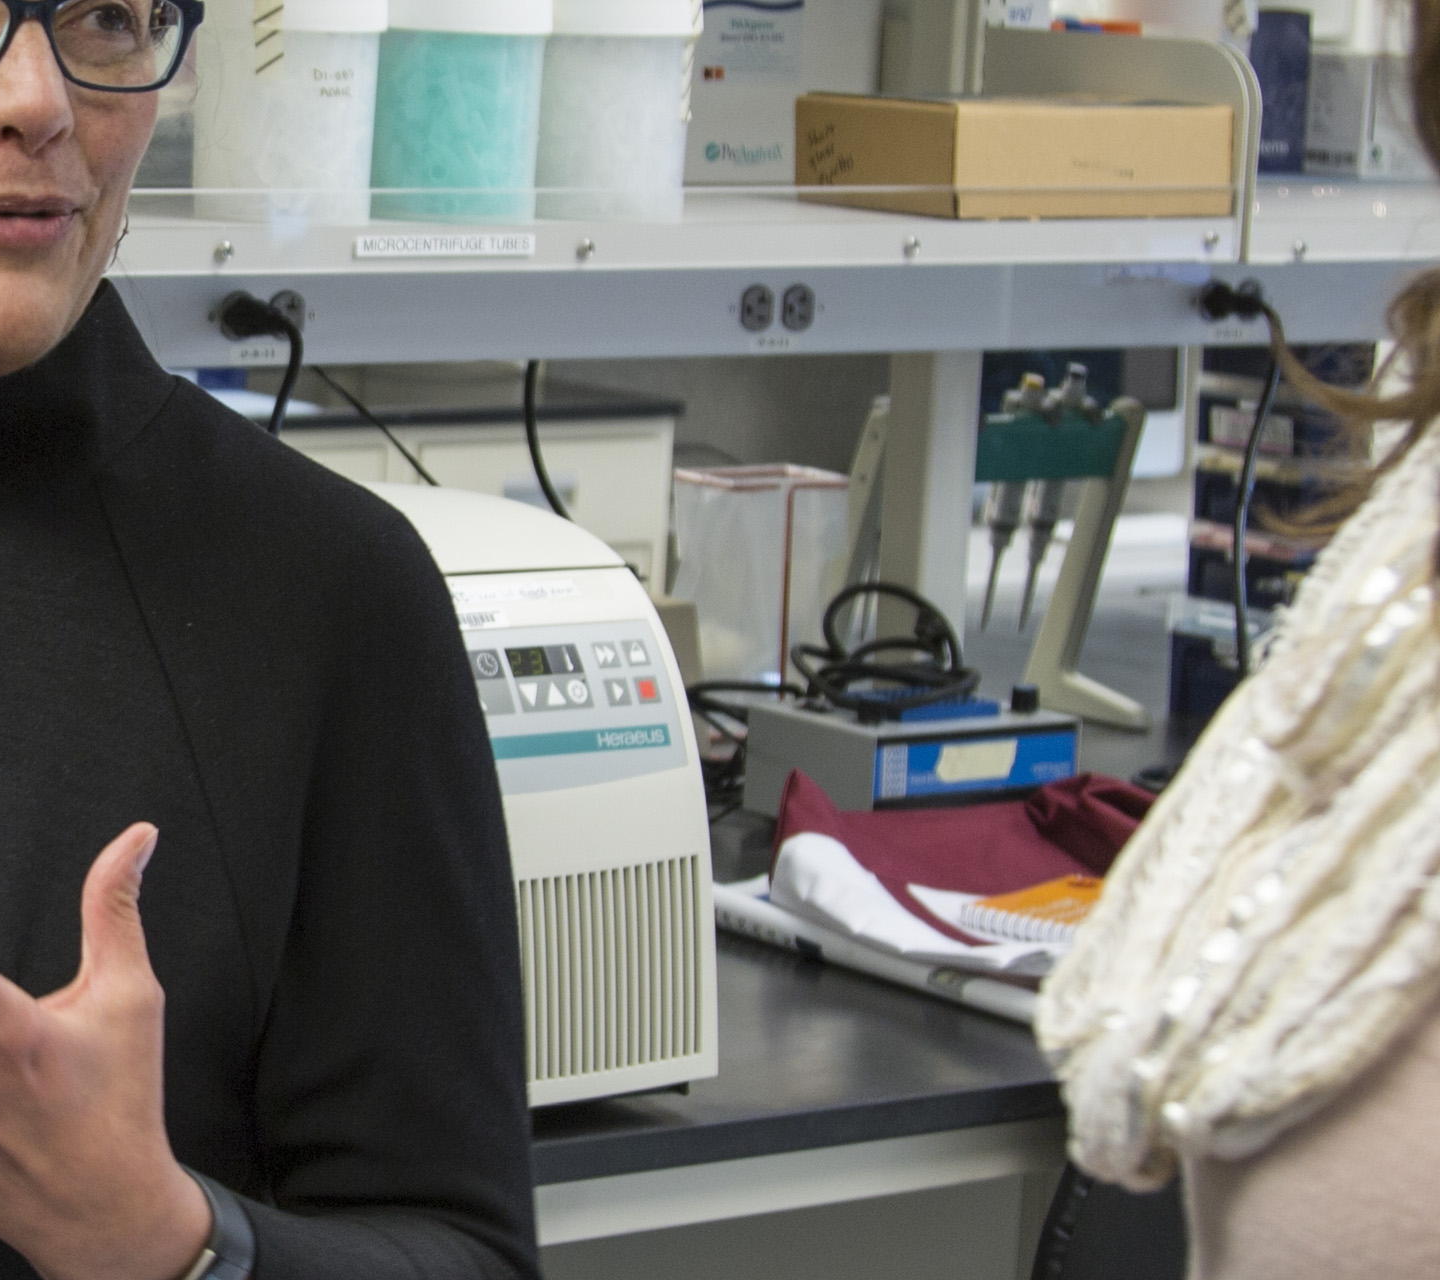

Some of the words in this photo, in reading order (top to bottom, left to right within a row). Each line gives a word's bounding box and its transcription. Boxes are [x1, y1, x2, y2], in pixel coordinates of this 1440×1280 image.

[363, 237, 487, 252] MICROCENTRIFUGE
[489, 236, 530, 250] TUBES
[597, 728, 665, 748] Heraeus
